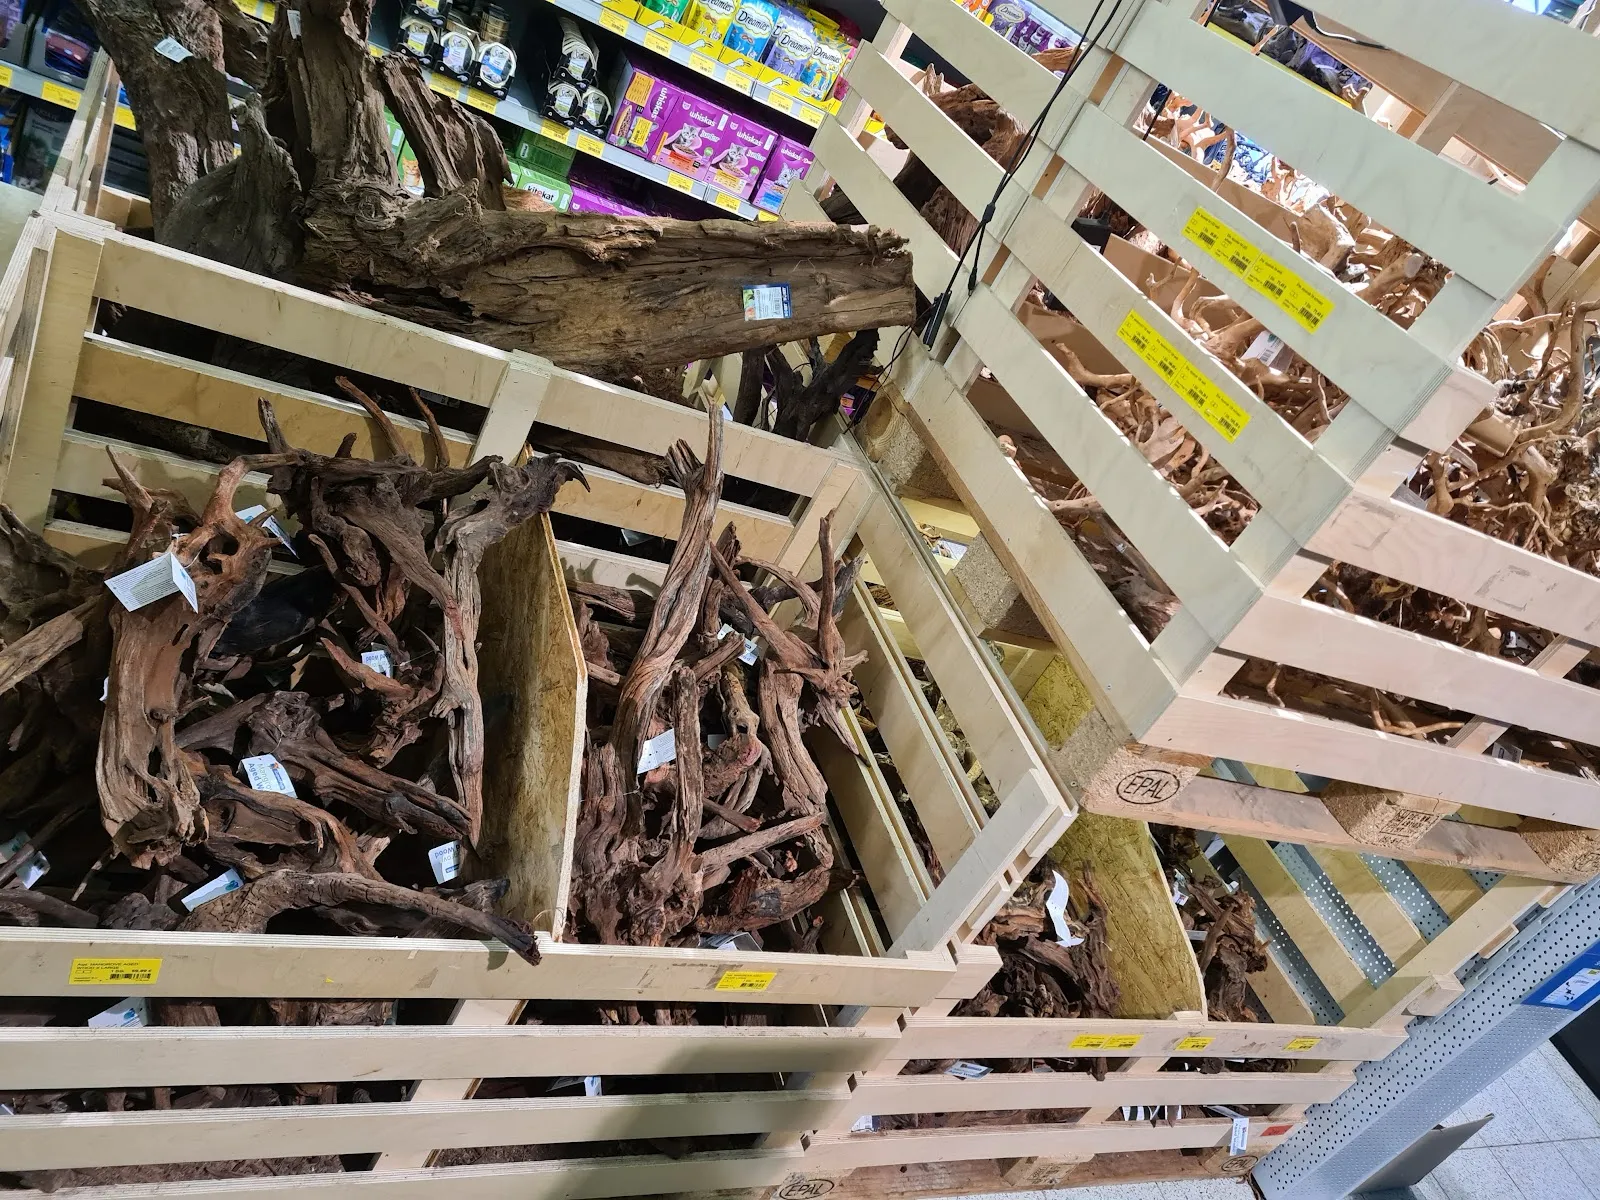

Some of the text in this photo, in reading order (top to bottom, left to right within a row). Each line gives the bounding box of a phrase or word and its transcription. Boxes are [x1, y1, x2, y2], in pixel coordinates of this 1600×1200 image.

[737, 10, 770, 32] Dreamies
[780, 34, 811, 53] Dreamies
[813, 45, 841, 64] Dreamies
[651, 87, 668, 120] whiskas
[689, 110, 716, 127] whiskas
[736, 131, 764, 147] whiskas
[780, 147, 803, 161] whiskas
[527, 185, 555, 201] kitekat
[247, 763, 260, 781] Aged
[257, 763, 274, 790] Mangro
[1123, 775, 1170, 800] EPAL
[434, 846, 456, 859] Wood
[784, 1182, 824, 1197] EPAL
